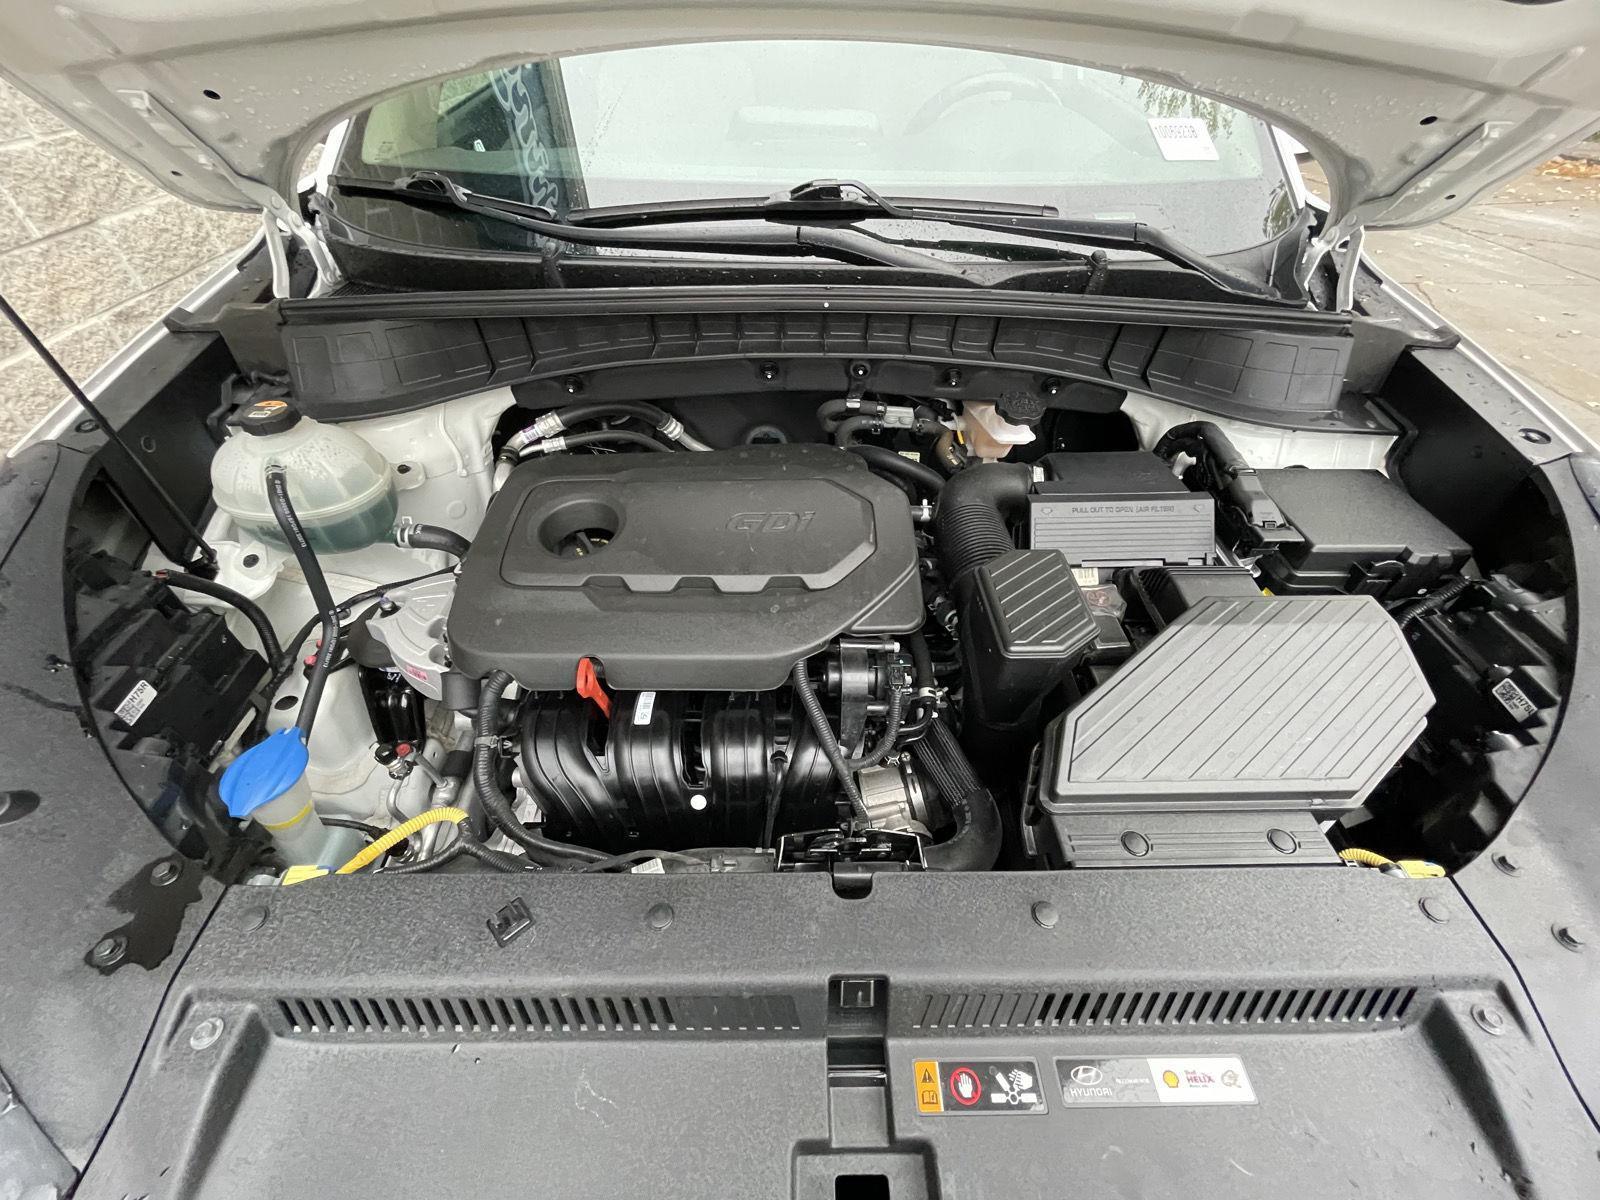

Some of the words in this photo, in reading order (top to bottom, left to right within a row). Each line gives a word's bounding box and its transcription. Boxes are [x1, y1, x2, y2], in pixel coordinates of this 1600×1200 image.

[1072, 506, 1089, 514] PULL
[1090, 505, 1104, 514] OUT
[1115, 505, 1133, 514] OPEN
[1069, 1087, 1113, 1097] HYUNDAI
